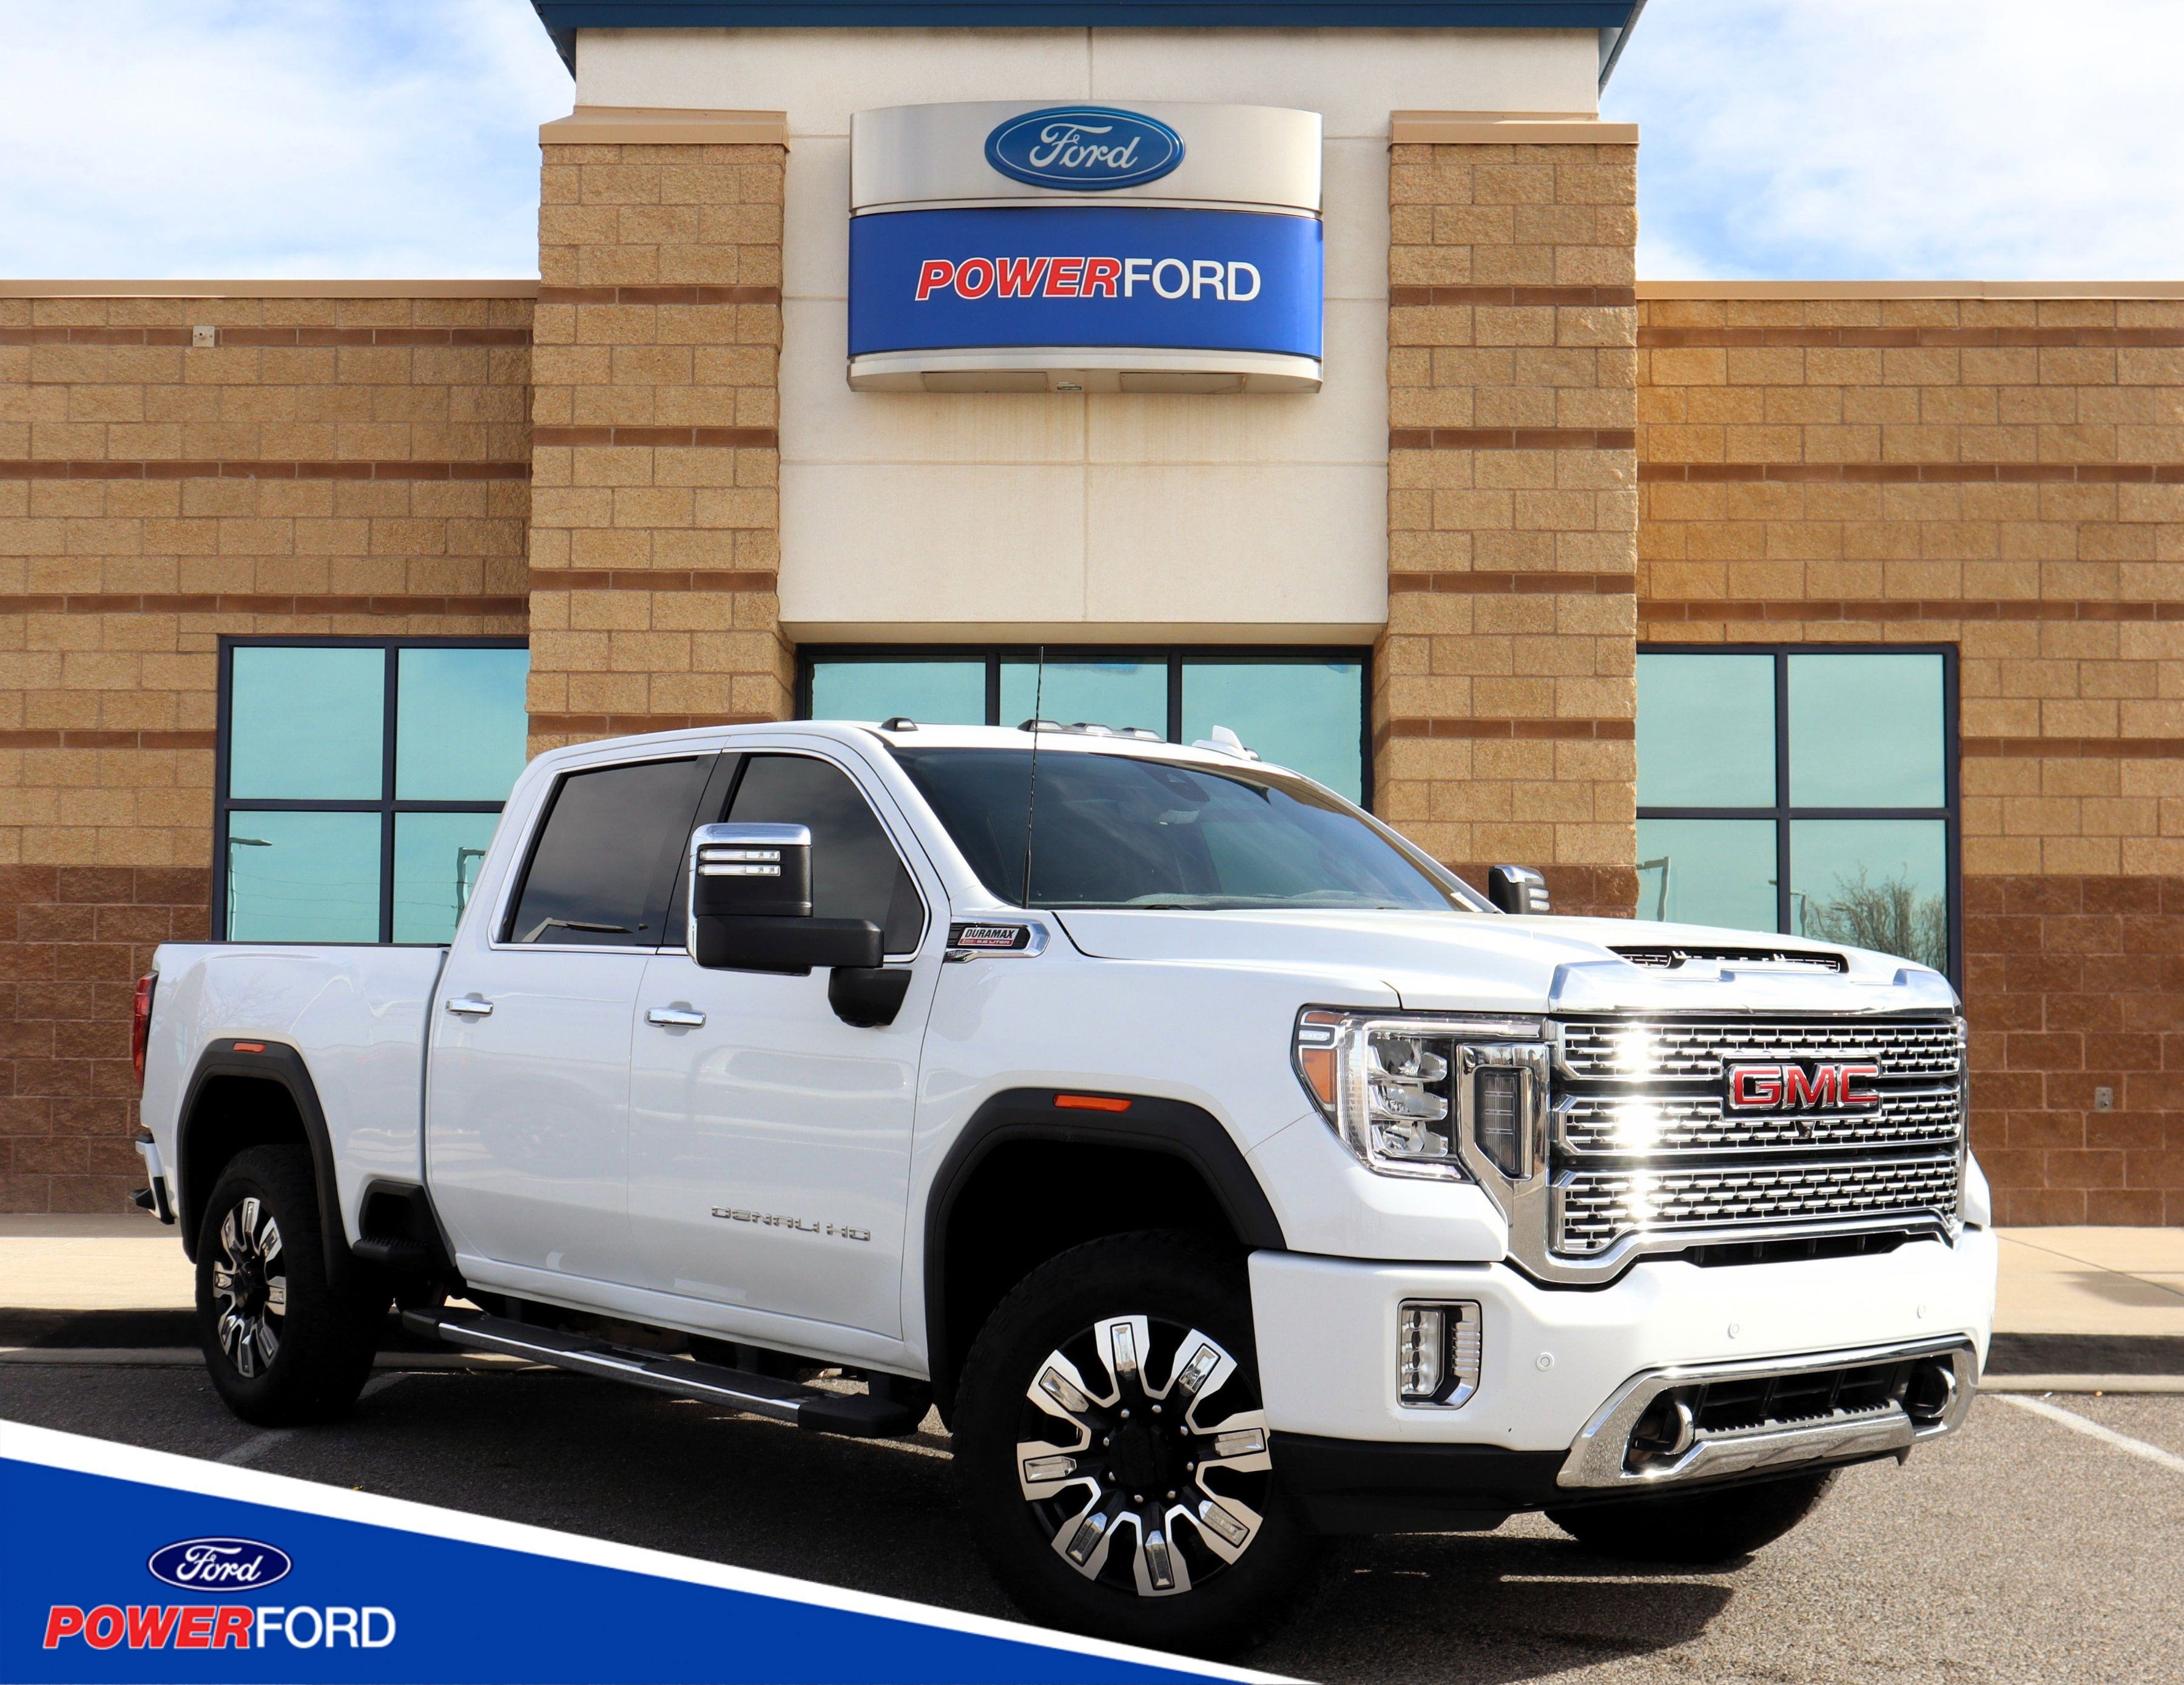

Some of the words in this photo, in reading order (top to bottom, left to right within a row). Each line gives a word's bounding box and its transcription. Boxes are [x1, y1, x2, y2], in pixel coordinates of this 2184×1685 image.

[1028, 123, 1140, 170] Ford
[965, 928, 1016, 939] DURAMAX
[1729, 1064, 1879, 1110] GMC
[711, 1205, 820, 1233] DENALI
[826, 1223, 871, 1241] HD
